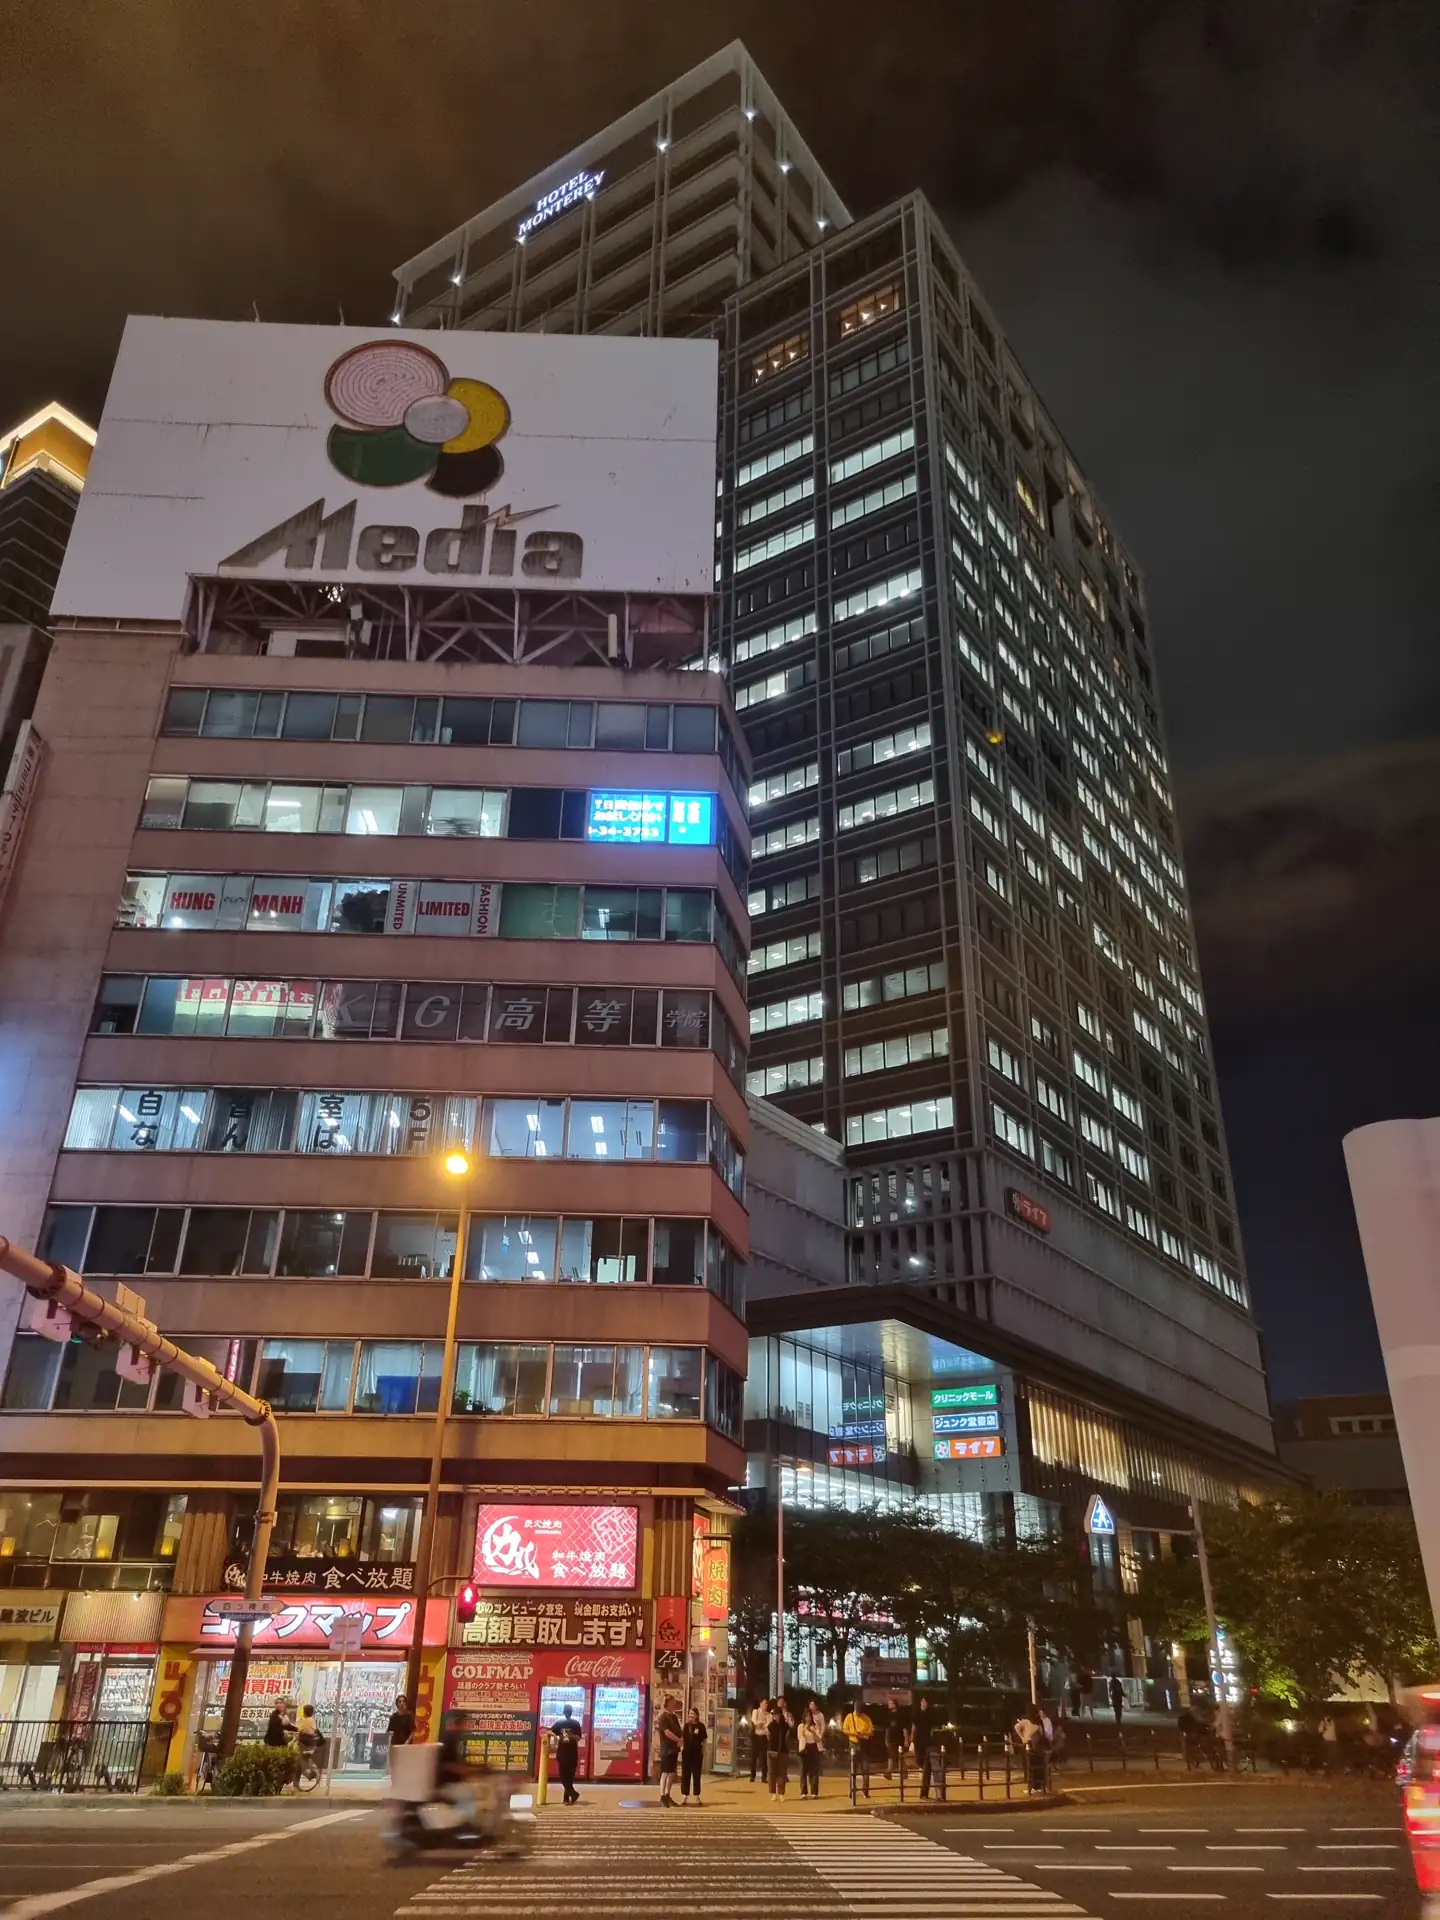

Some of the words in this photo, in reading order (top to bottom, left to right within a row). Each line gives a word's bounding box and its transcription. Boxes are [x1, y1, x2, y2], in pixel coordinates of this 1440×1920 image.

[536, 172, 588, 211] HOTEL
[518, 170, 605, 236] MONTEREY
[218, 498, 583, 578] Media
[170, 892, 215, 911] HUNG
[252, 895, 303, 914] MANH
[418, 901, 470, 916] LIMITED
[477, 884, 491, 934] FASHION
[1023, 1200, 1047, 1225] ライフ
[933, 1391, 994, 1404] クリニックモール
[935, 1415, 996, 1429] ジュンク堂書店
[954, 1440, 995, 1455] ライフ
[552, 1550, 606, 1562] 和牛焼肉
[322, 1566, 413, 1590] 食べ放題
[551, 1561, 627, 1580] 食べ放題
[707, 1560, 724, 1607] 焼肉
[462, 1617, 643, 1646] 高額買取します!
[451, 1665, 534, 1679] GOLFMAP
[671, 1657, 683, 1668] 2F
